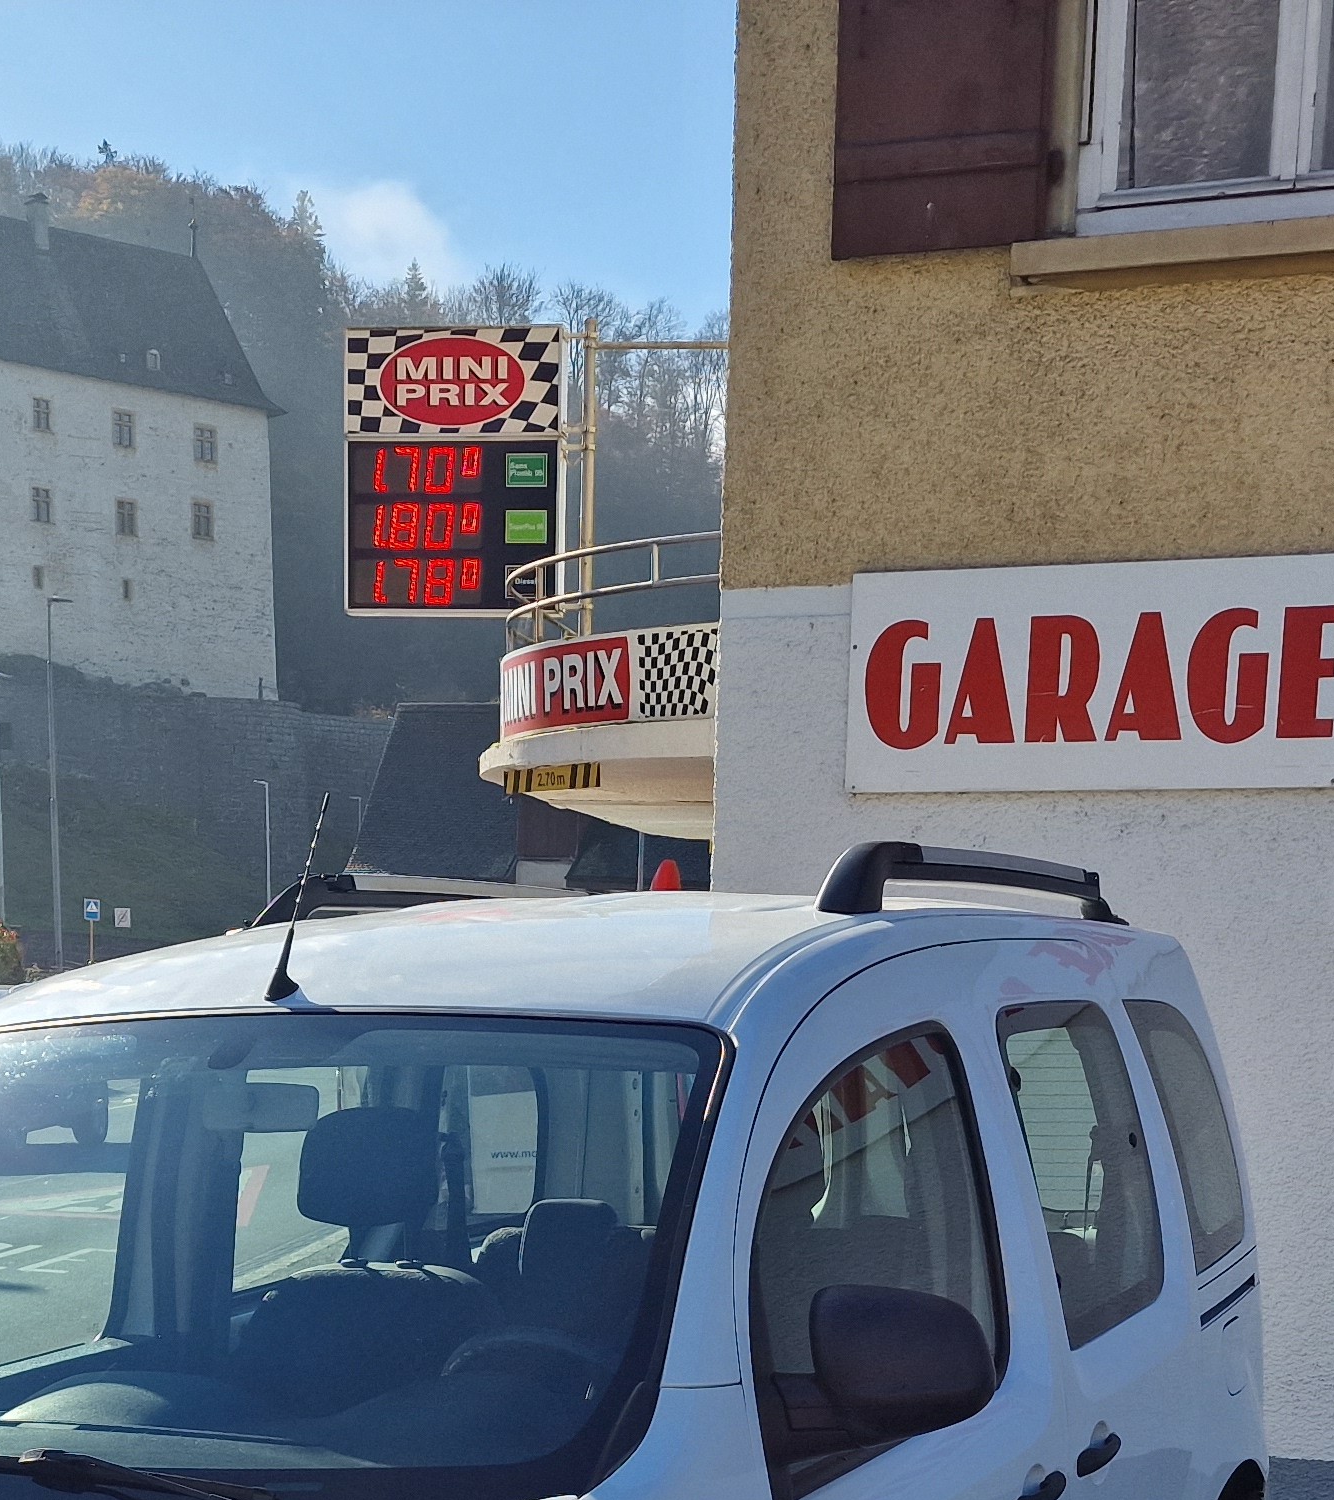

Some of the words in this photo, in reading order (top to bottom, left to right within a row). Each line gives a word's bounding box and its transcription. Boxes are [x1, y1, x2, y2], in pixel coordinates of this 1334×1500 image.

[394, 356, 509, 380] MINI
[394, 382, 510, 407] PRIX
[543, 647, 624, 714] PRIX
